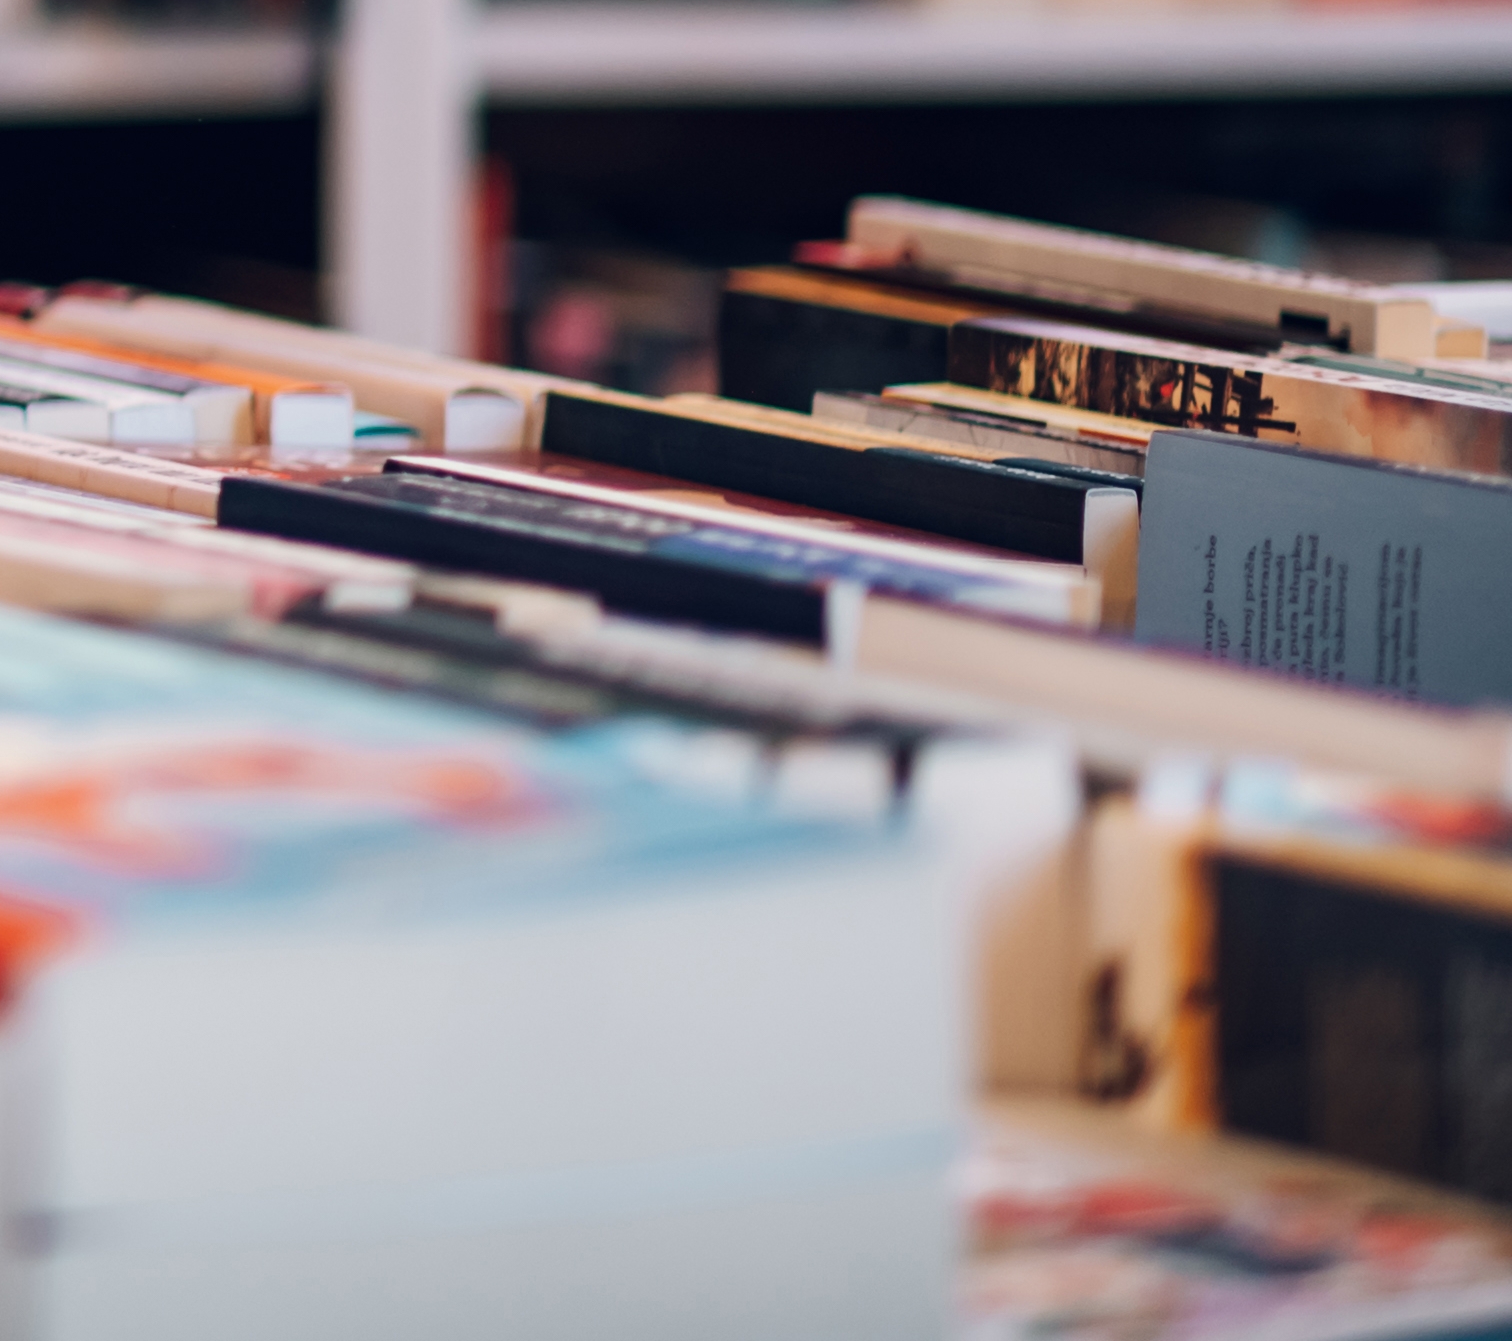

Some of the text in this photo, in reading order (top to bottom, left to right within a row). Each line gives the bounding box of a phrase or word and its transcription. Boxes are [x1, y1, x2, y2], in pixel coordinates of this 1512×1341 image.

[1203, 534, 1218, 594] borbe
[1289, 534, 1303, 605] klupko
[1306, 534, 1320, 572] kad
[1258, 538, 1273, 667] posmatranja
[1289, 611, 1300, 657] puta
